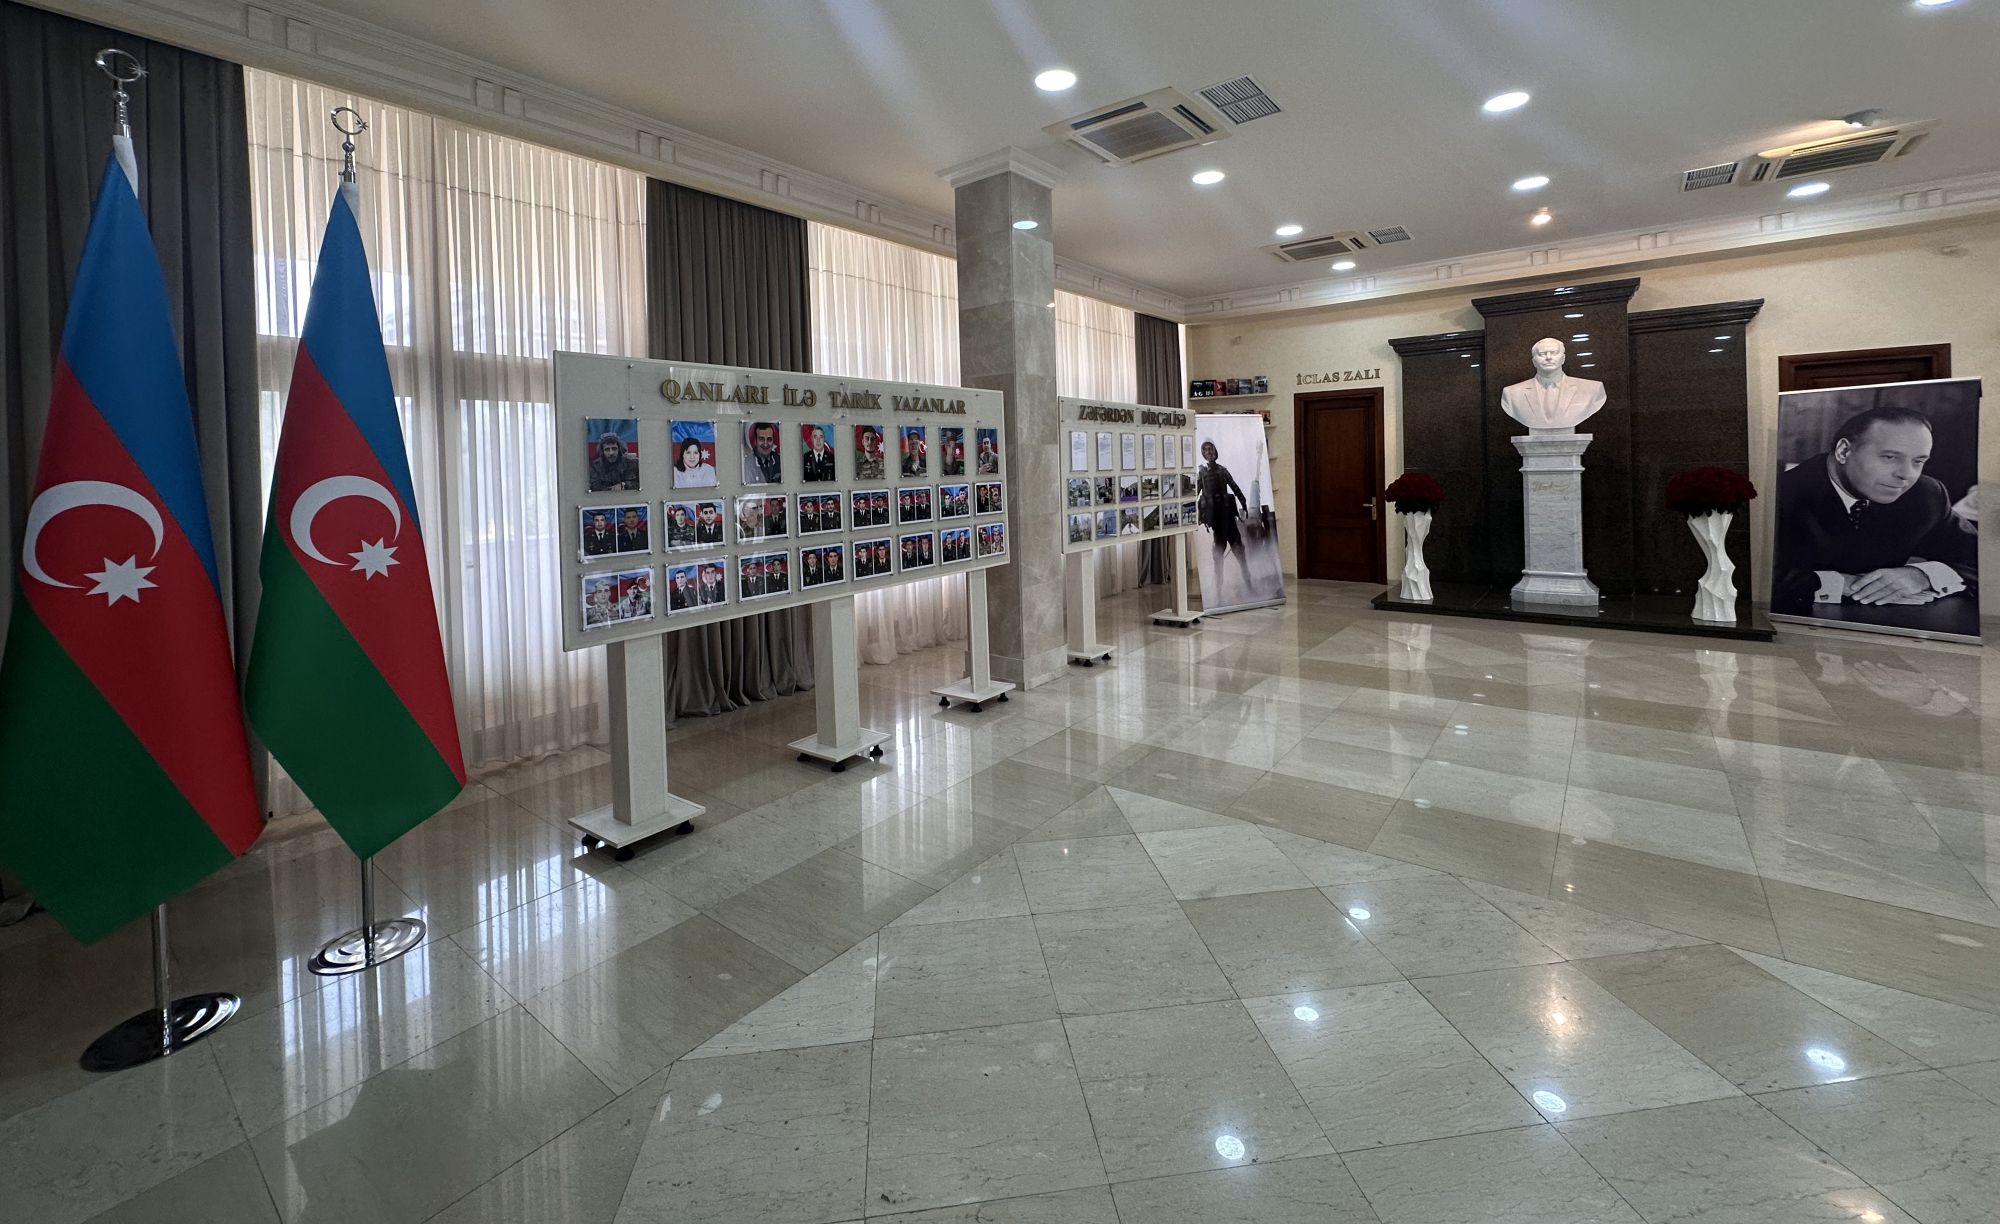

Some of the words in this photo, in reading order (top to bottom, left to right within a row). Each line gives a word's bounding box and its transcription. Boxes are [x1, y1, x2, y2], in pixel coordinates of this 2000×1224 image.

[1296, 371, 1340, 386] İCLAS
[1343, 368, 1381, 382] ZALI
[660, 379, 770, 405] QANLARI
[782, 383, 817, 407] İLƏ
[828, 388, 883, 410] TARİX
[892, 395, 967, 415] YAZANLAR
[1078, 404, 1135, 424] ZƏFƏRDƏN
